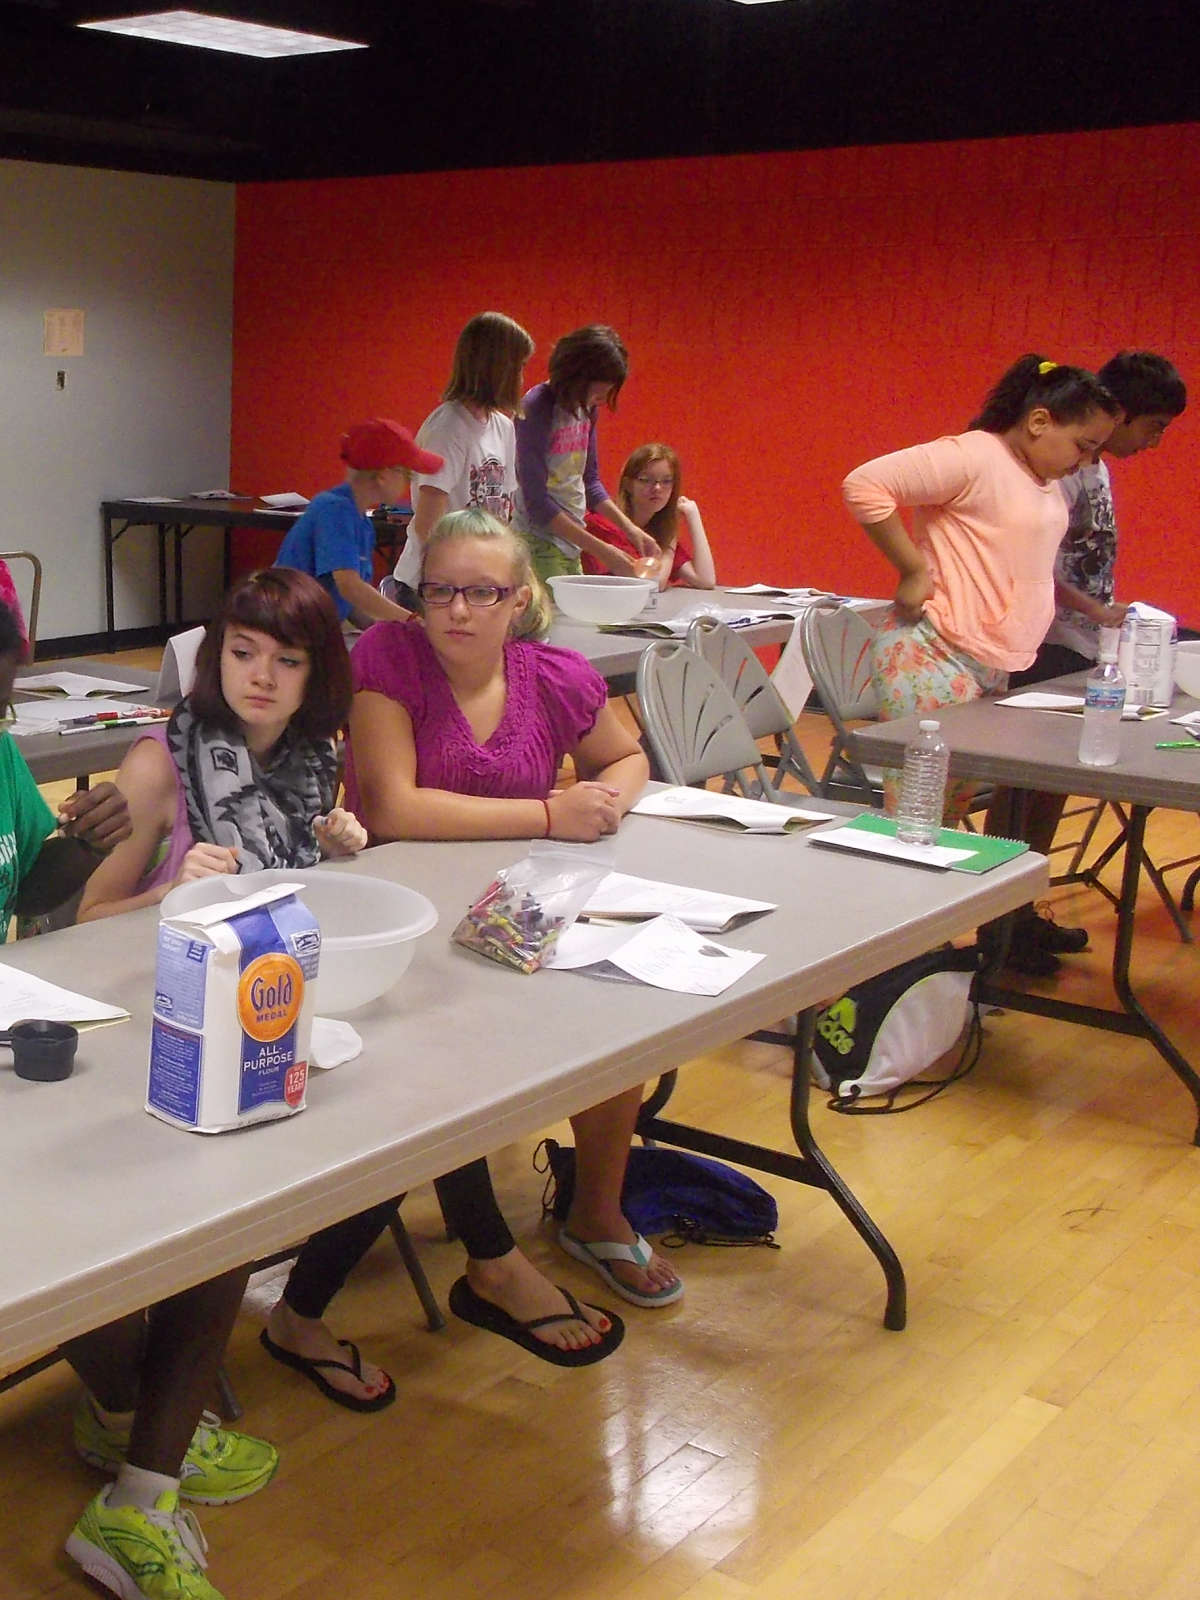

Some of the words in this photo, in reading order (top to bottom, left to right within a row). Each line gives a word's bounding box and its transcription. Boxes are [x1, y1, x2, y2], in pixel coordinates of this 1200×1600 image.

[251, 973, 291, 1011] Gold
[256, 1009, 288, 1023] MEDAL
[243, 1050, 294, 1072] PURPOSE
